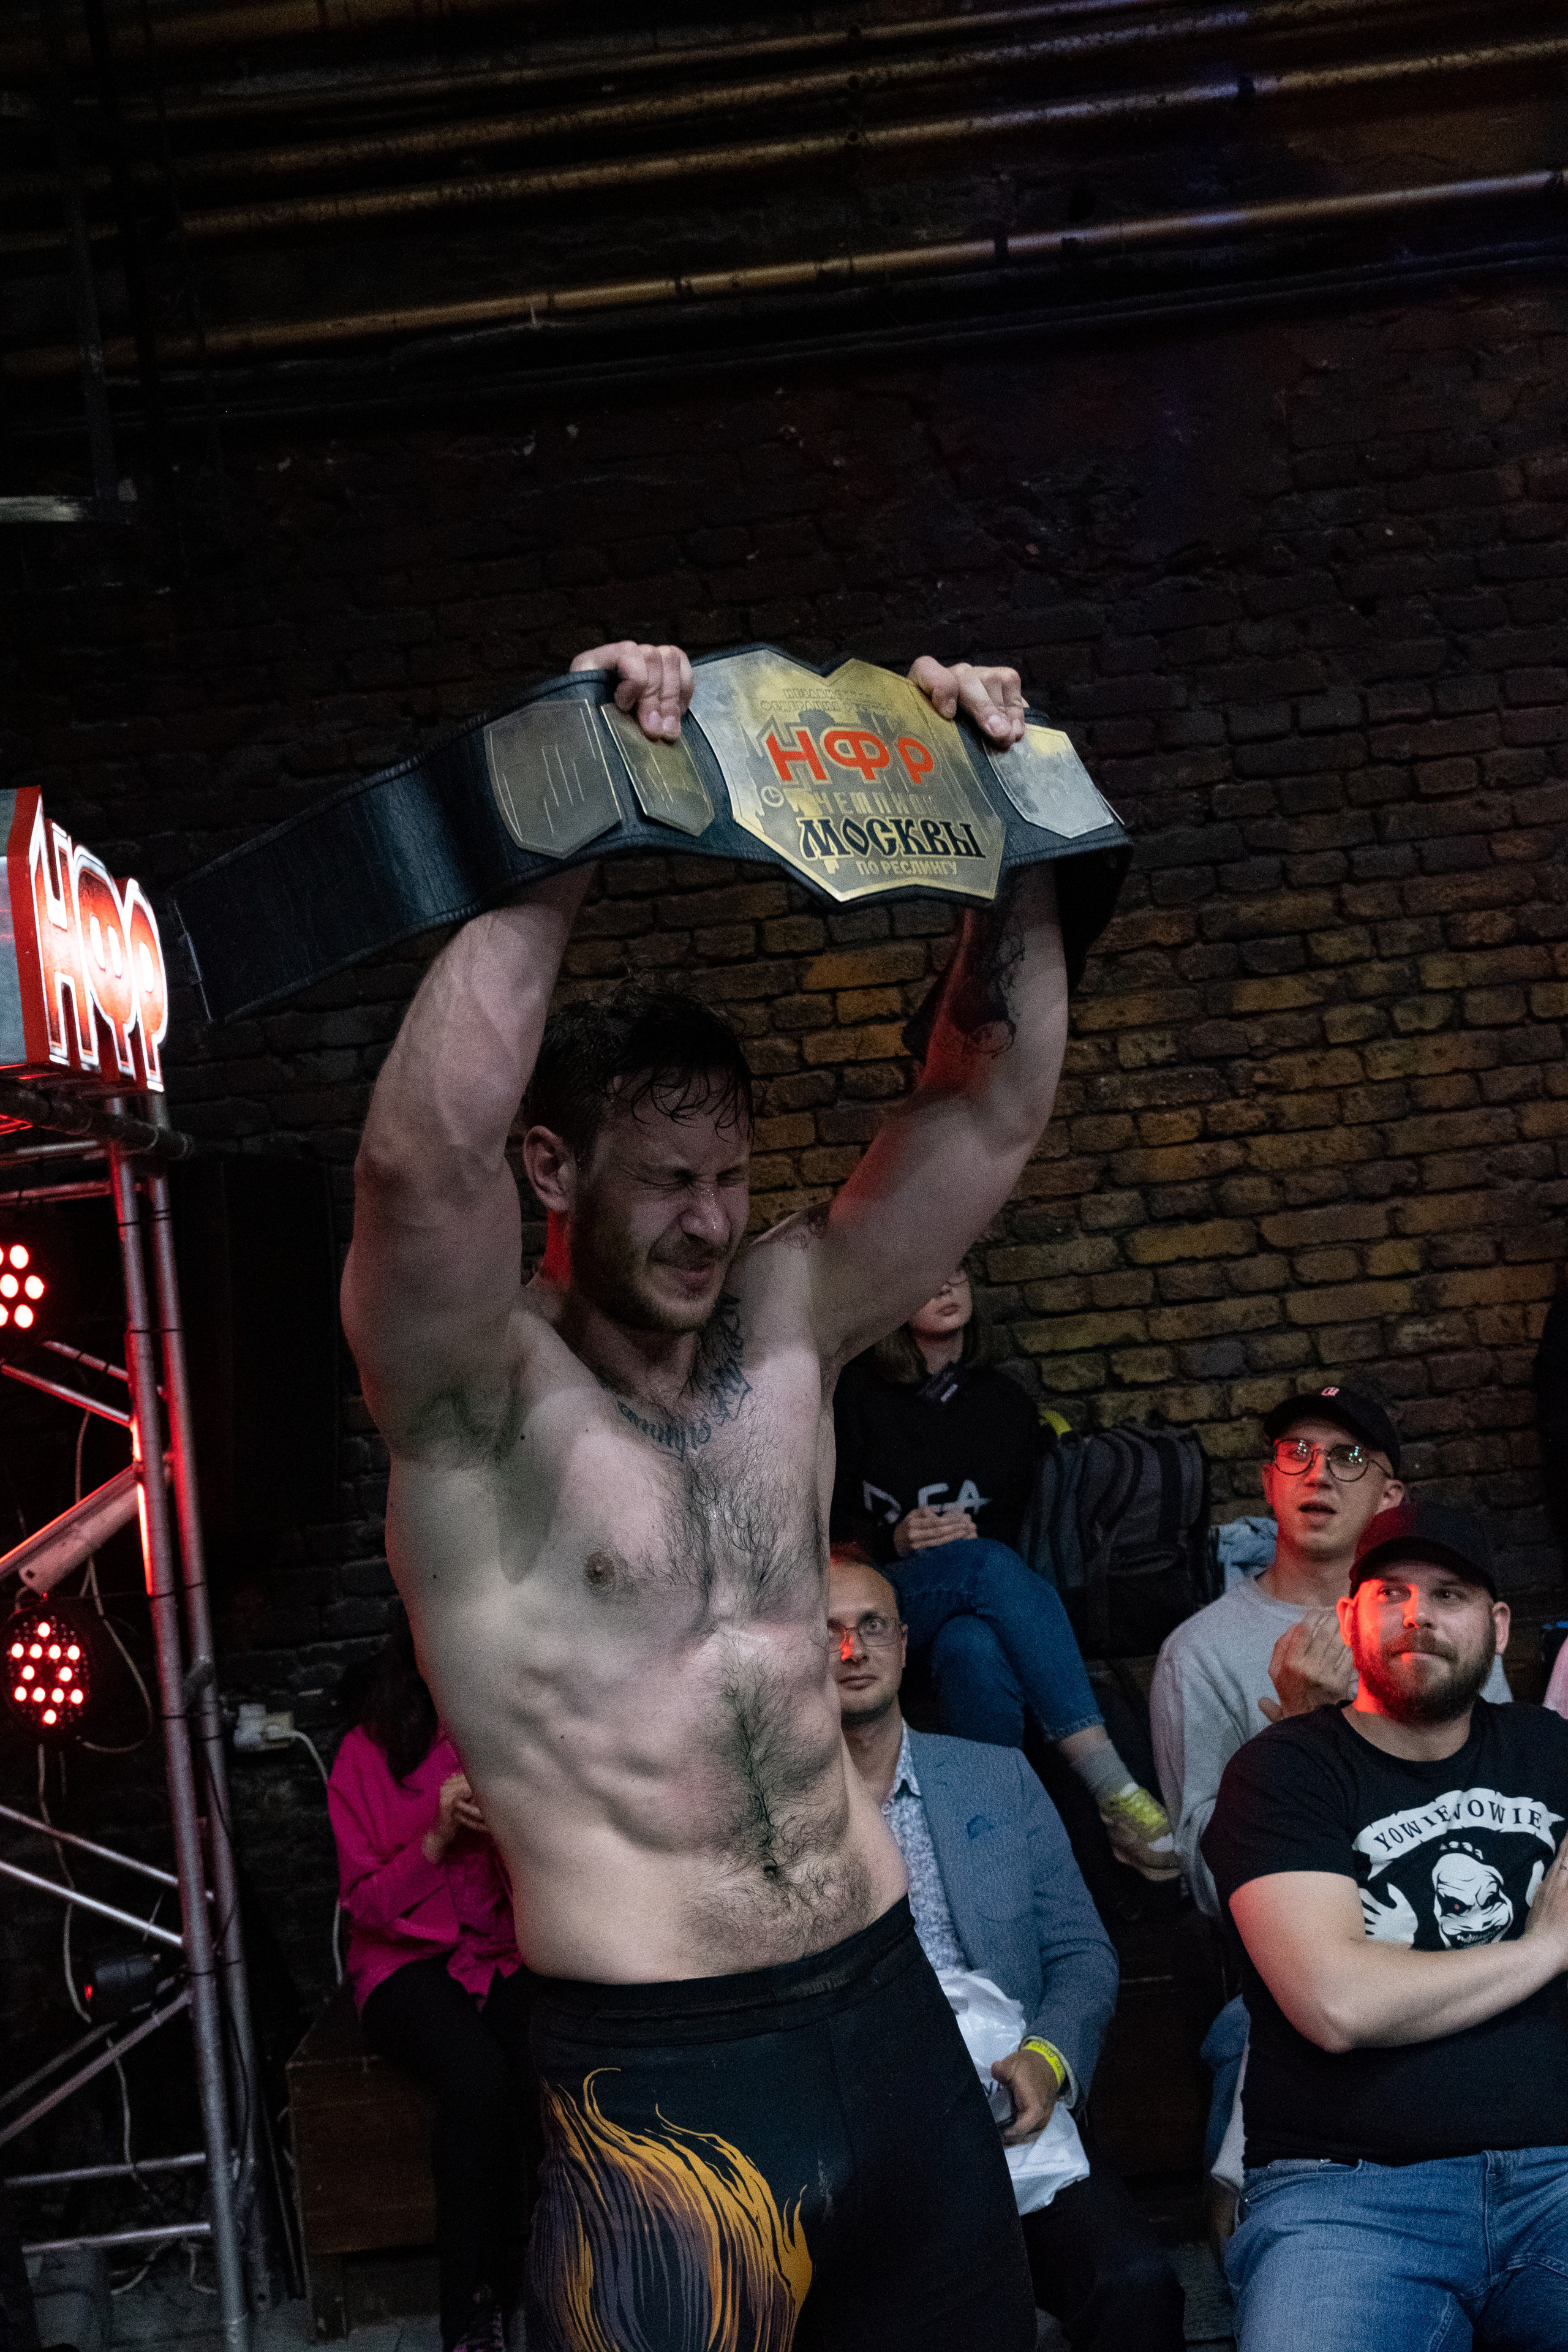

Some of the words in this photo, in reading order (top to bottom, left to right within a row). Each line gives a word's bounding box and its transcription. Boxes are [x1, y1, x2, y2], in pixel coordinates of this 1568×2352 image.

[766, 729, 934, 783] НФР
[814, 791, 941, 816] ЧЕМПИОН
[799, 818, 986, 860] МОСКВЫ
[857, 861, 880, 875] ПО
[881, 861, 957, 876] РЕСЛИНГУ
[28, 794, 168, 1093] НФР
[1374, 1805, 1451, 1852] YOWIE
